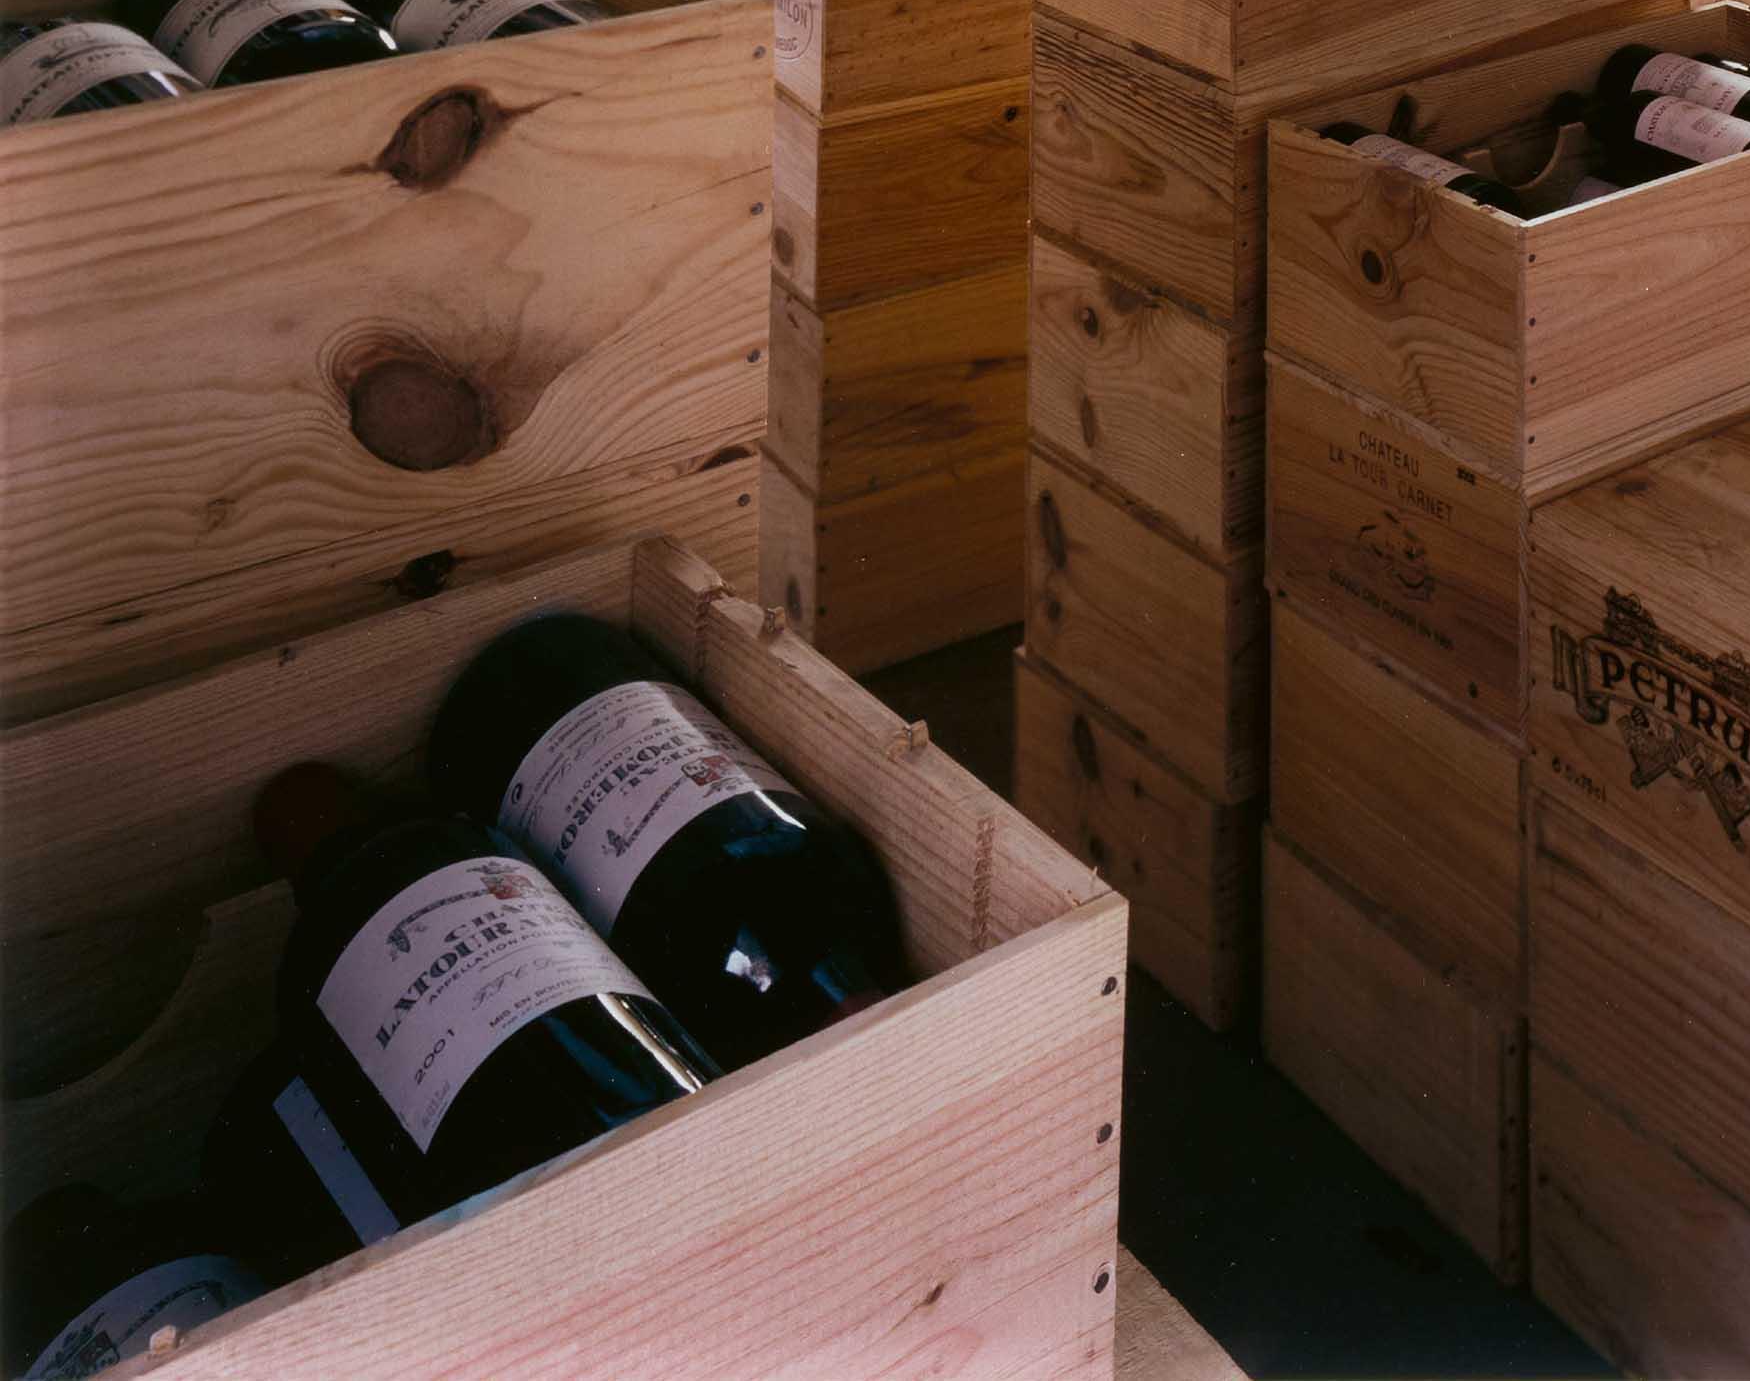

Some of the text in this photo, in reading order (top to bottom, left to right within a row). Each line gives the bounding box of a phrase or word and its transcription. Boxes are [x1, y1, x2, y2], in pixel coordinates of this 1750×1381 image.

[1329, 443, 1453, 522] LA TOUR CARNET
[1360, 432, 1419, 477] CHATEAU
[374, 920, 513, 1051] LATOUR
[414, 1028, 455, 1086] 2001
